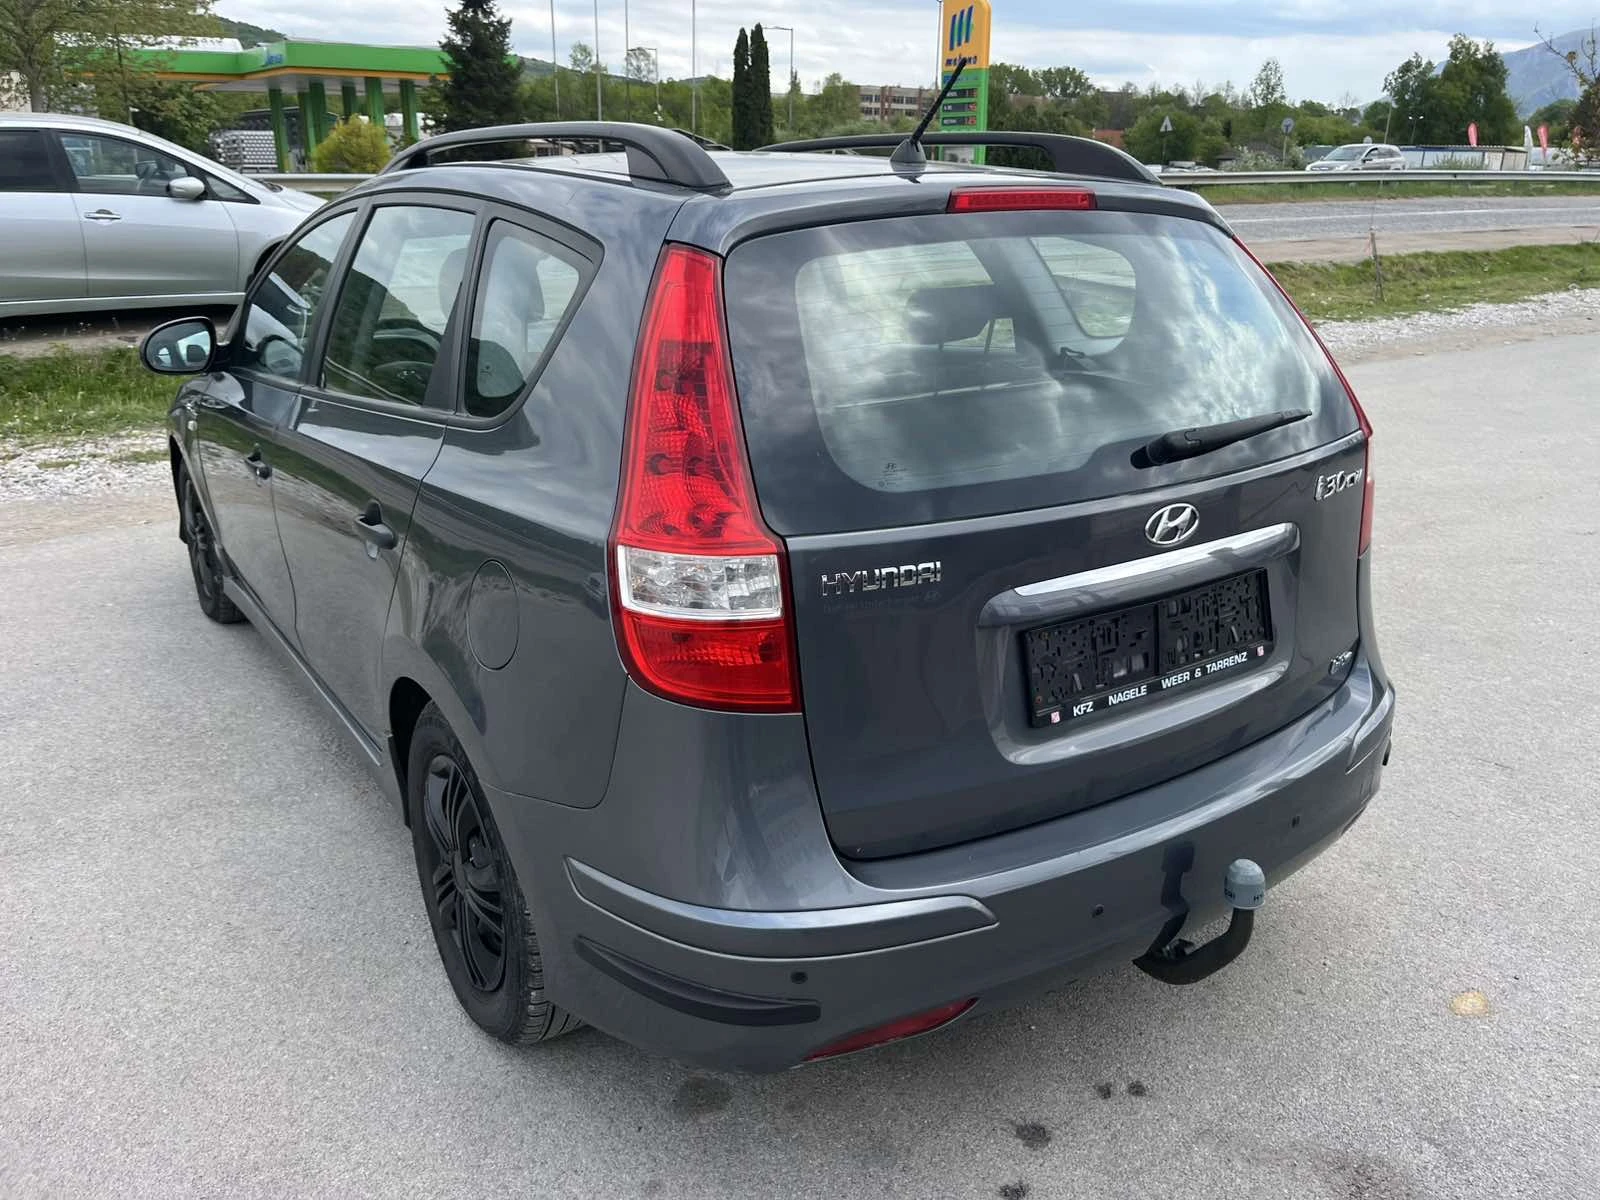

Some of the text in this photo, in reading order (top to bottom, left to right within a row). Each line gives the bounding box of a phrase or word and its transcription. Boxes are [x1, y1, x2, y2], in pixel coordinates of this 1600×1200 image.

[821, 561, 942, 596] HYUNDAI
[1073, 651, 1248, 716] KFZ NAGELE WEER & TARRENZ
